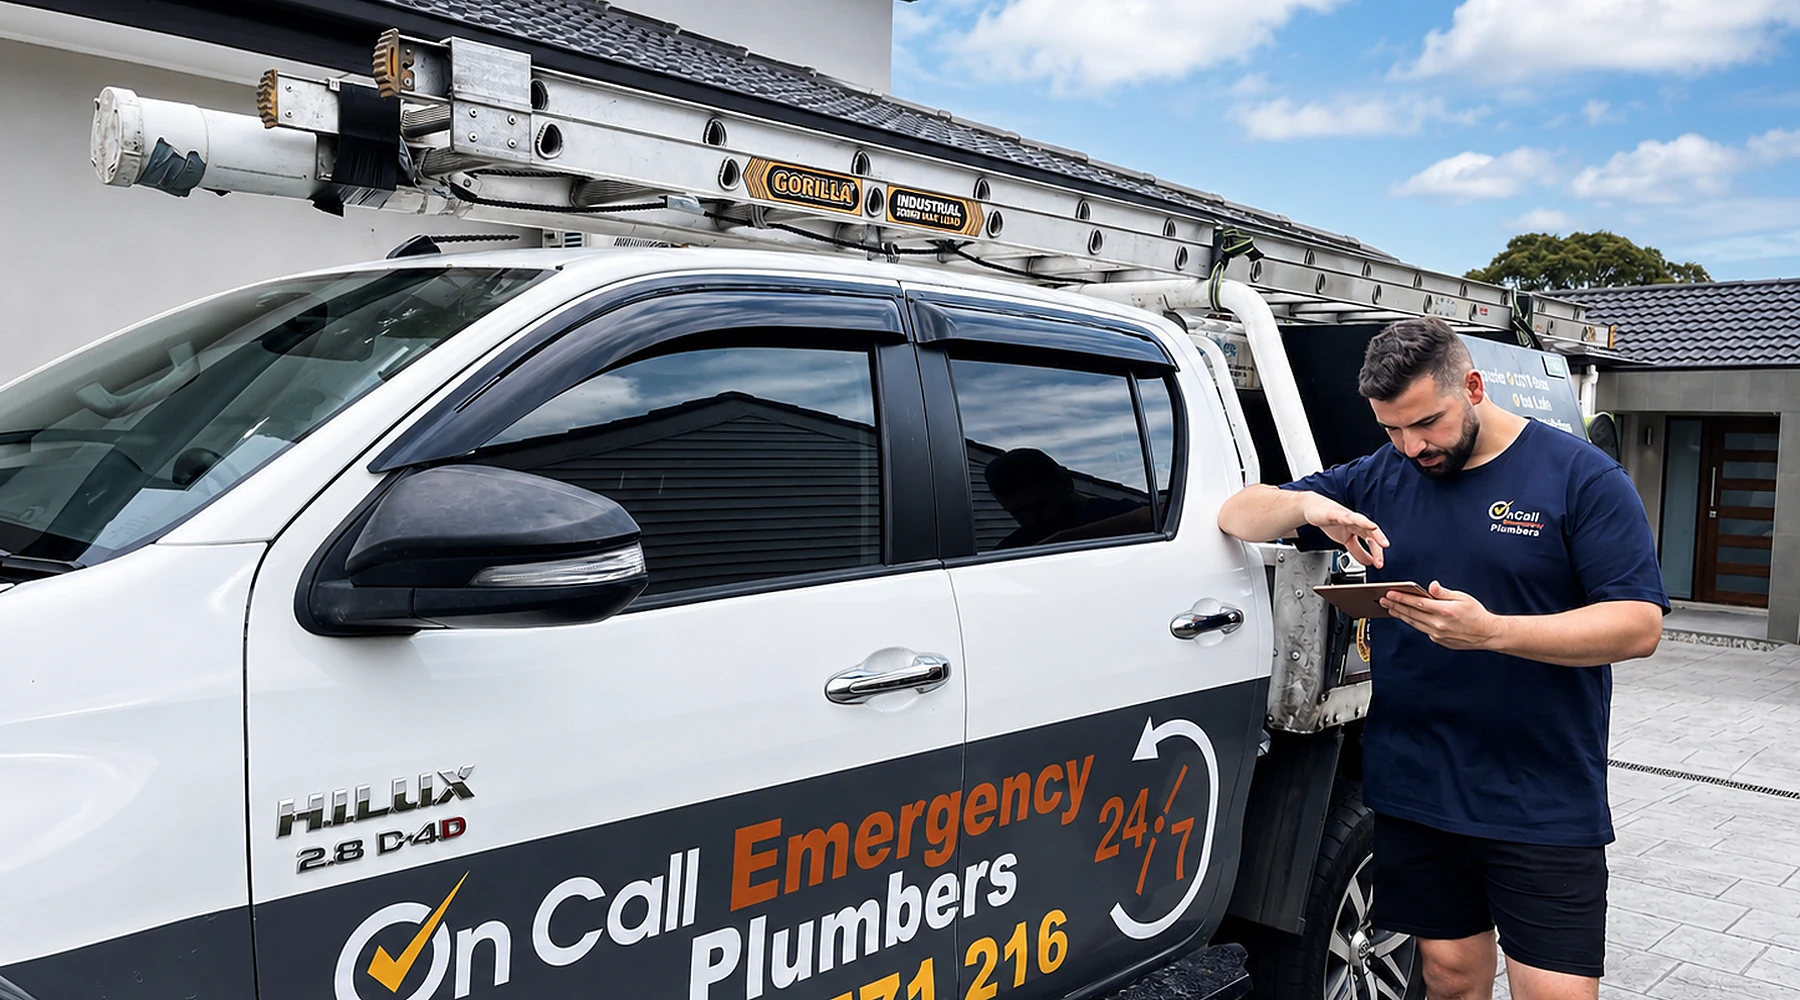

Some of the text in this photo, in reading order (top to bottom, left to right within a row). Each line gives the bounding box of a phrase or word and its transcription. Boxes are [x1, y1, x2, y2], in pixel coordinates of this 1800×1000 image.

[772, 171, 854, 205] GORILLA
[897, 194, 961, 217] INDUSTRIAL
[1490, 523, 1540, 537] Plumbers
[276, 764, 475, 839] HILUX
[296, 839, 364, 874] 2.8
[334, 755, 1095, 1000] On Call Emergency
[689, 852, 1018, 1000] Plumbers
[964, 909, 1069, 1000] 216
